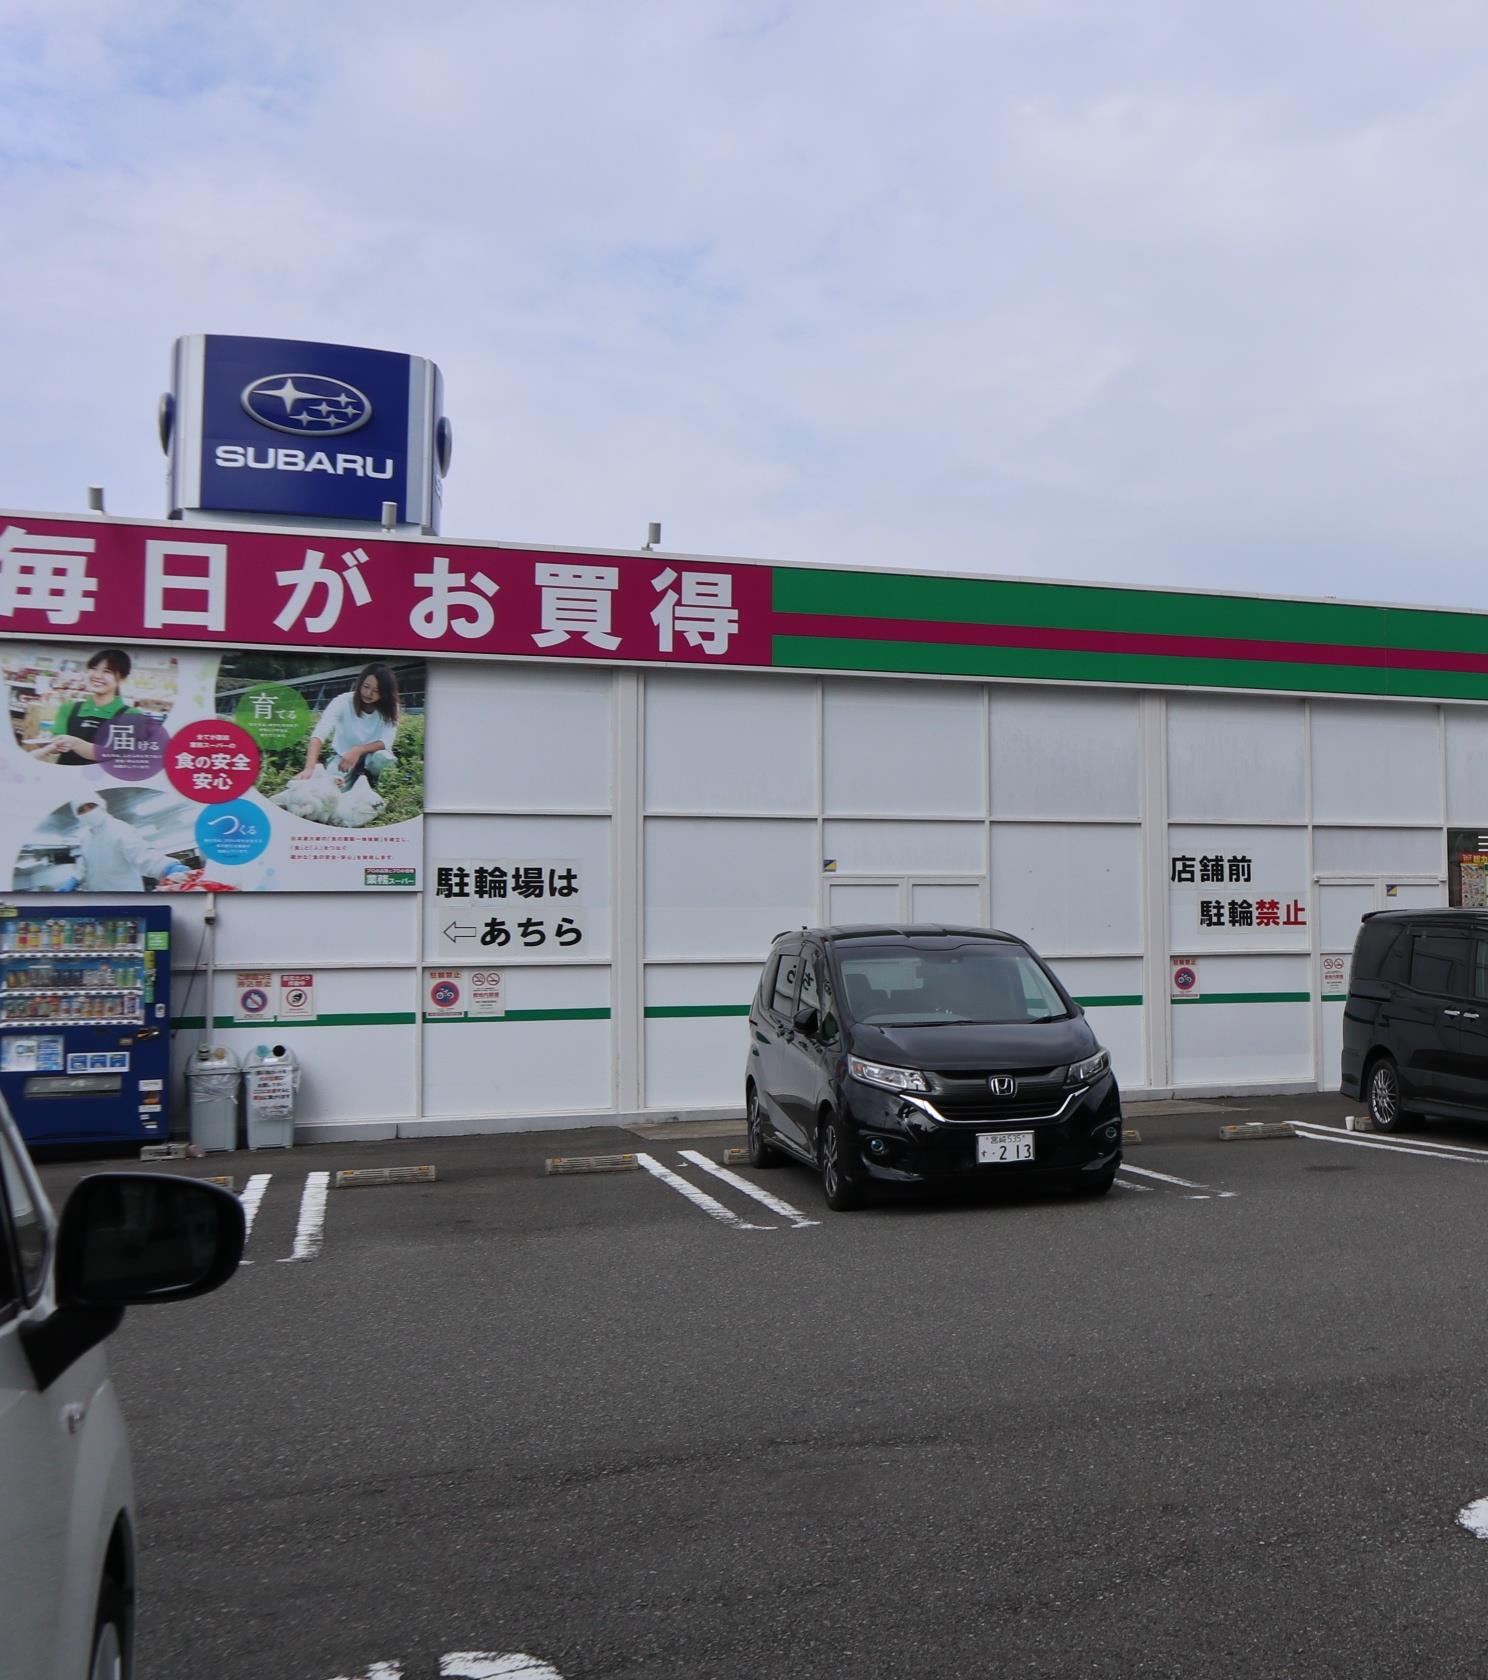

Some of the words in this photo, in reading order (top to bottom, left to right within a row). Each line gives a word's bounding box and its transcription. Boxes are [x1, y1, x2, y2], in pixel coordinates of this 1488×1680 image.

[215, 445, 393, 480] SUBARU
[0, 525, 739, 655] 毎日がお買得
[249, 692, 297, 719] 育てる
[104, 724, 160, 751] 届ける
[175, 752, 251, 770] 食の安全
[192, 773, 233, 790] 安心
[207, 815, 257, 836] つくる
[436, 866, 580, 899] 駐輪場は
[1170, 856, 1253, 884] 店舗前
[1200, 900, 1307, 928] 駐輪禁止
[480, 916, 583, 948] あちら
[999, 1144, 1032, 1160] 213
